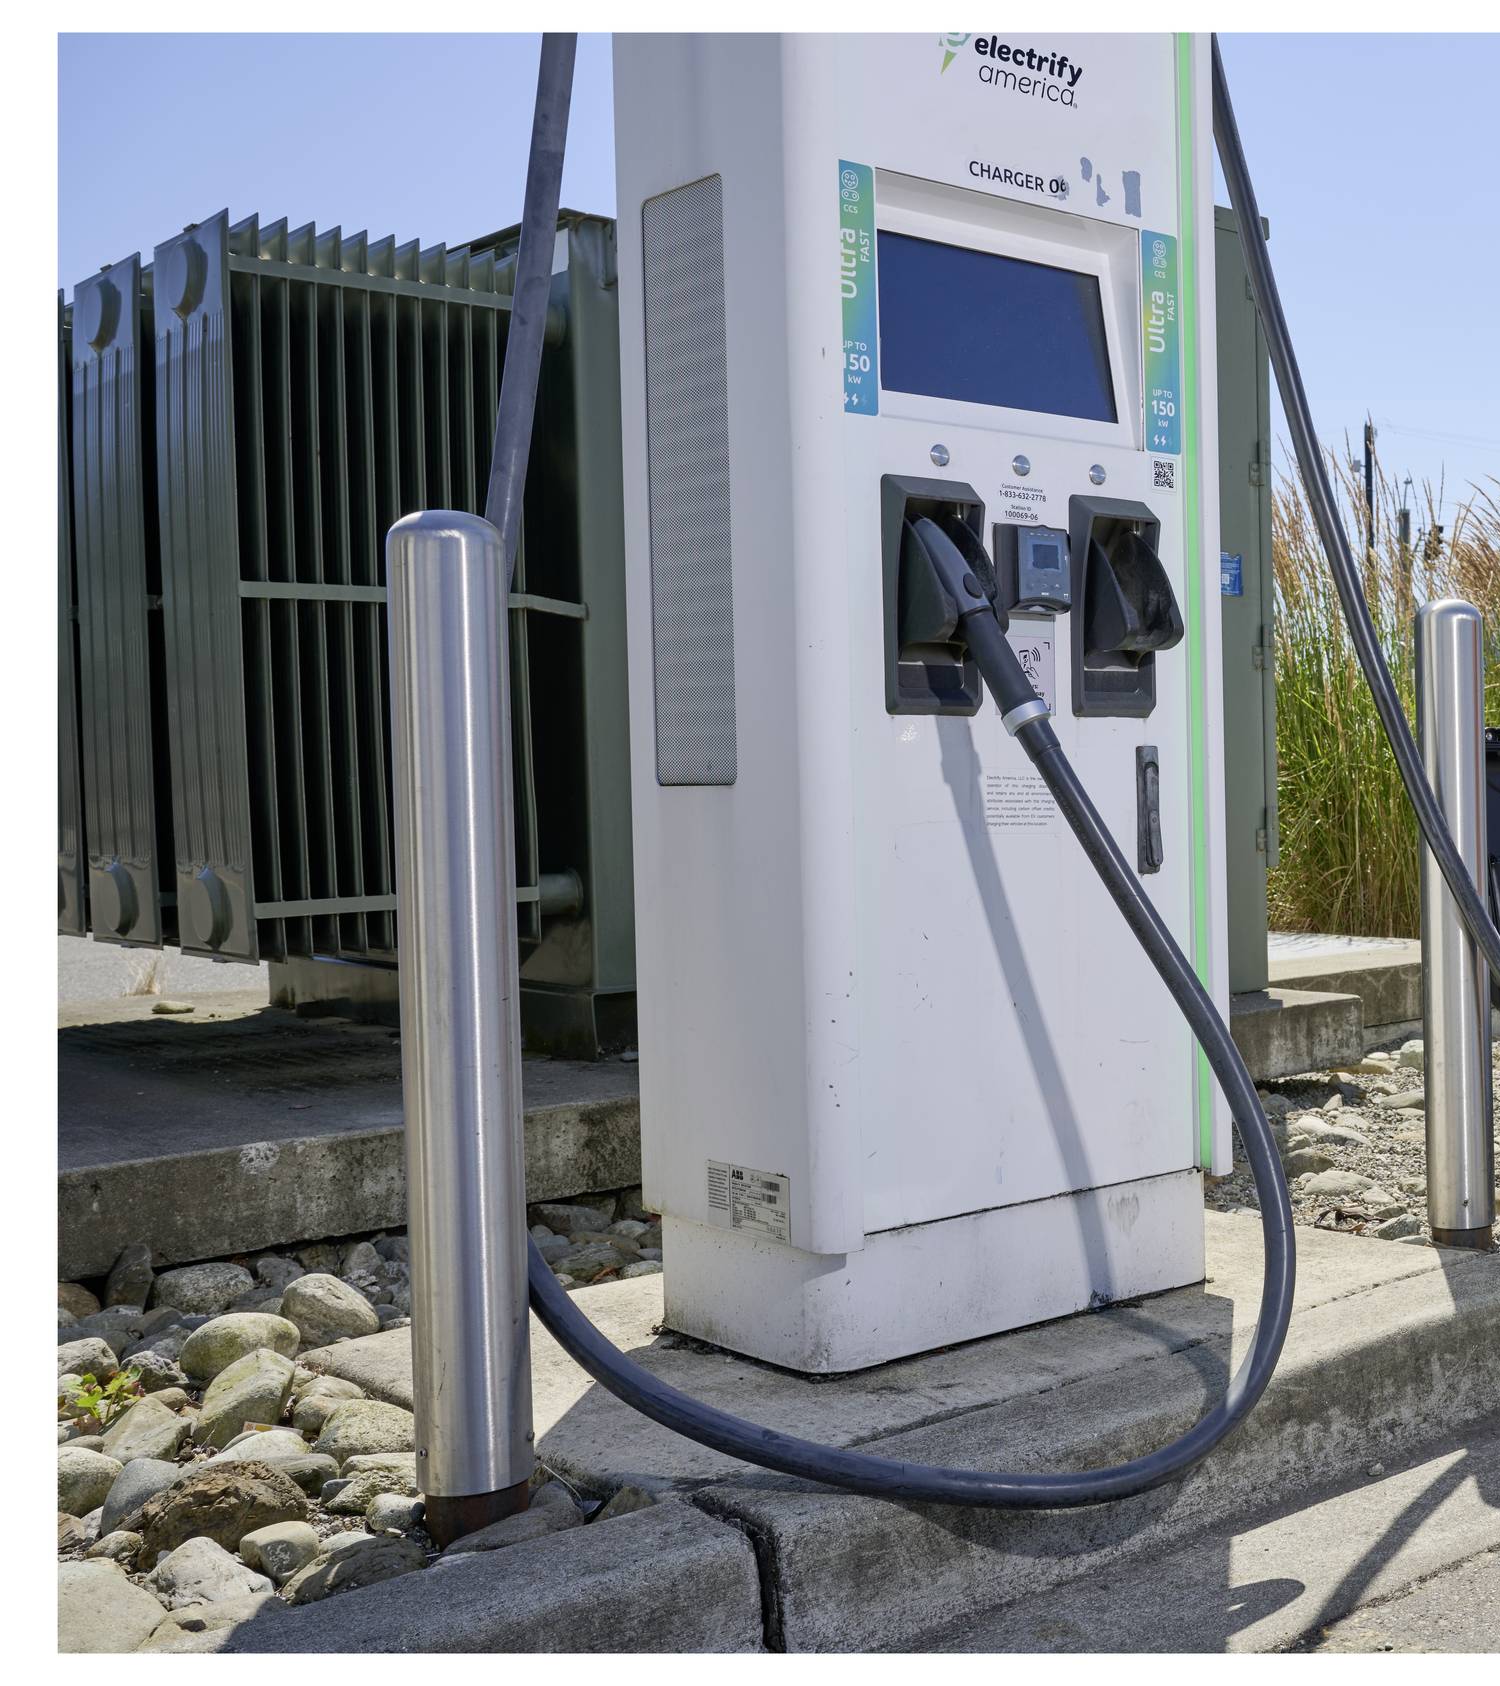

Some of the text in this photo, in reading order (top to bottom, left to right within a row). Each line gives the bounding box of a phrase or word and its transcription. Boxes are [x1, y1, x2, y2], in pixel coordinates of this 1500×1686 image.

[974, 35, 1083, 87] electrify
[978, 65, 1075, 107] america
[968, 160, 1045, 193] CHARGER
[860, 228, 870, 263] FAST
[840, 228, 857, 299] Ultra
[1166, 291, 1175, 321] FAST
[1148, 290, 1166, 353] Ultra
[855, 341, 867, 351] TO
[843, 352, 871, 372] 150
[847, 374, 862, 385] kW
[1152, 388, 1173, 399] UP TO
[1151, 399, 1175, 417] 150
[732, 1169, 744, 1180] ABB
